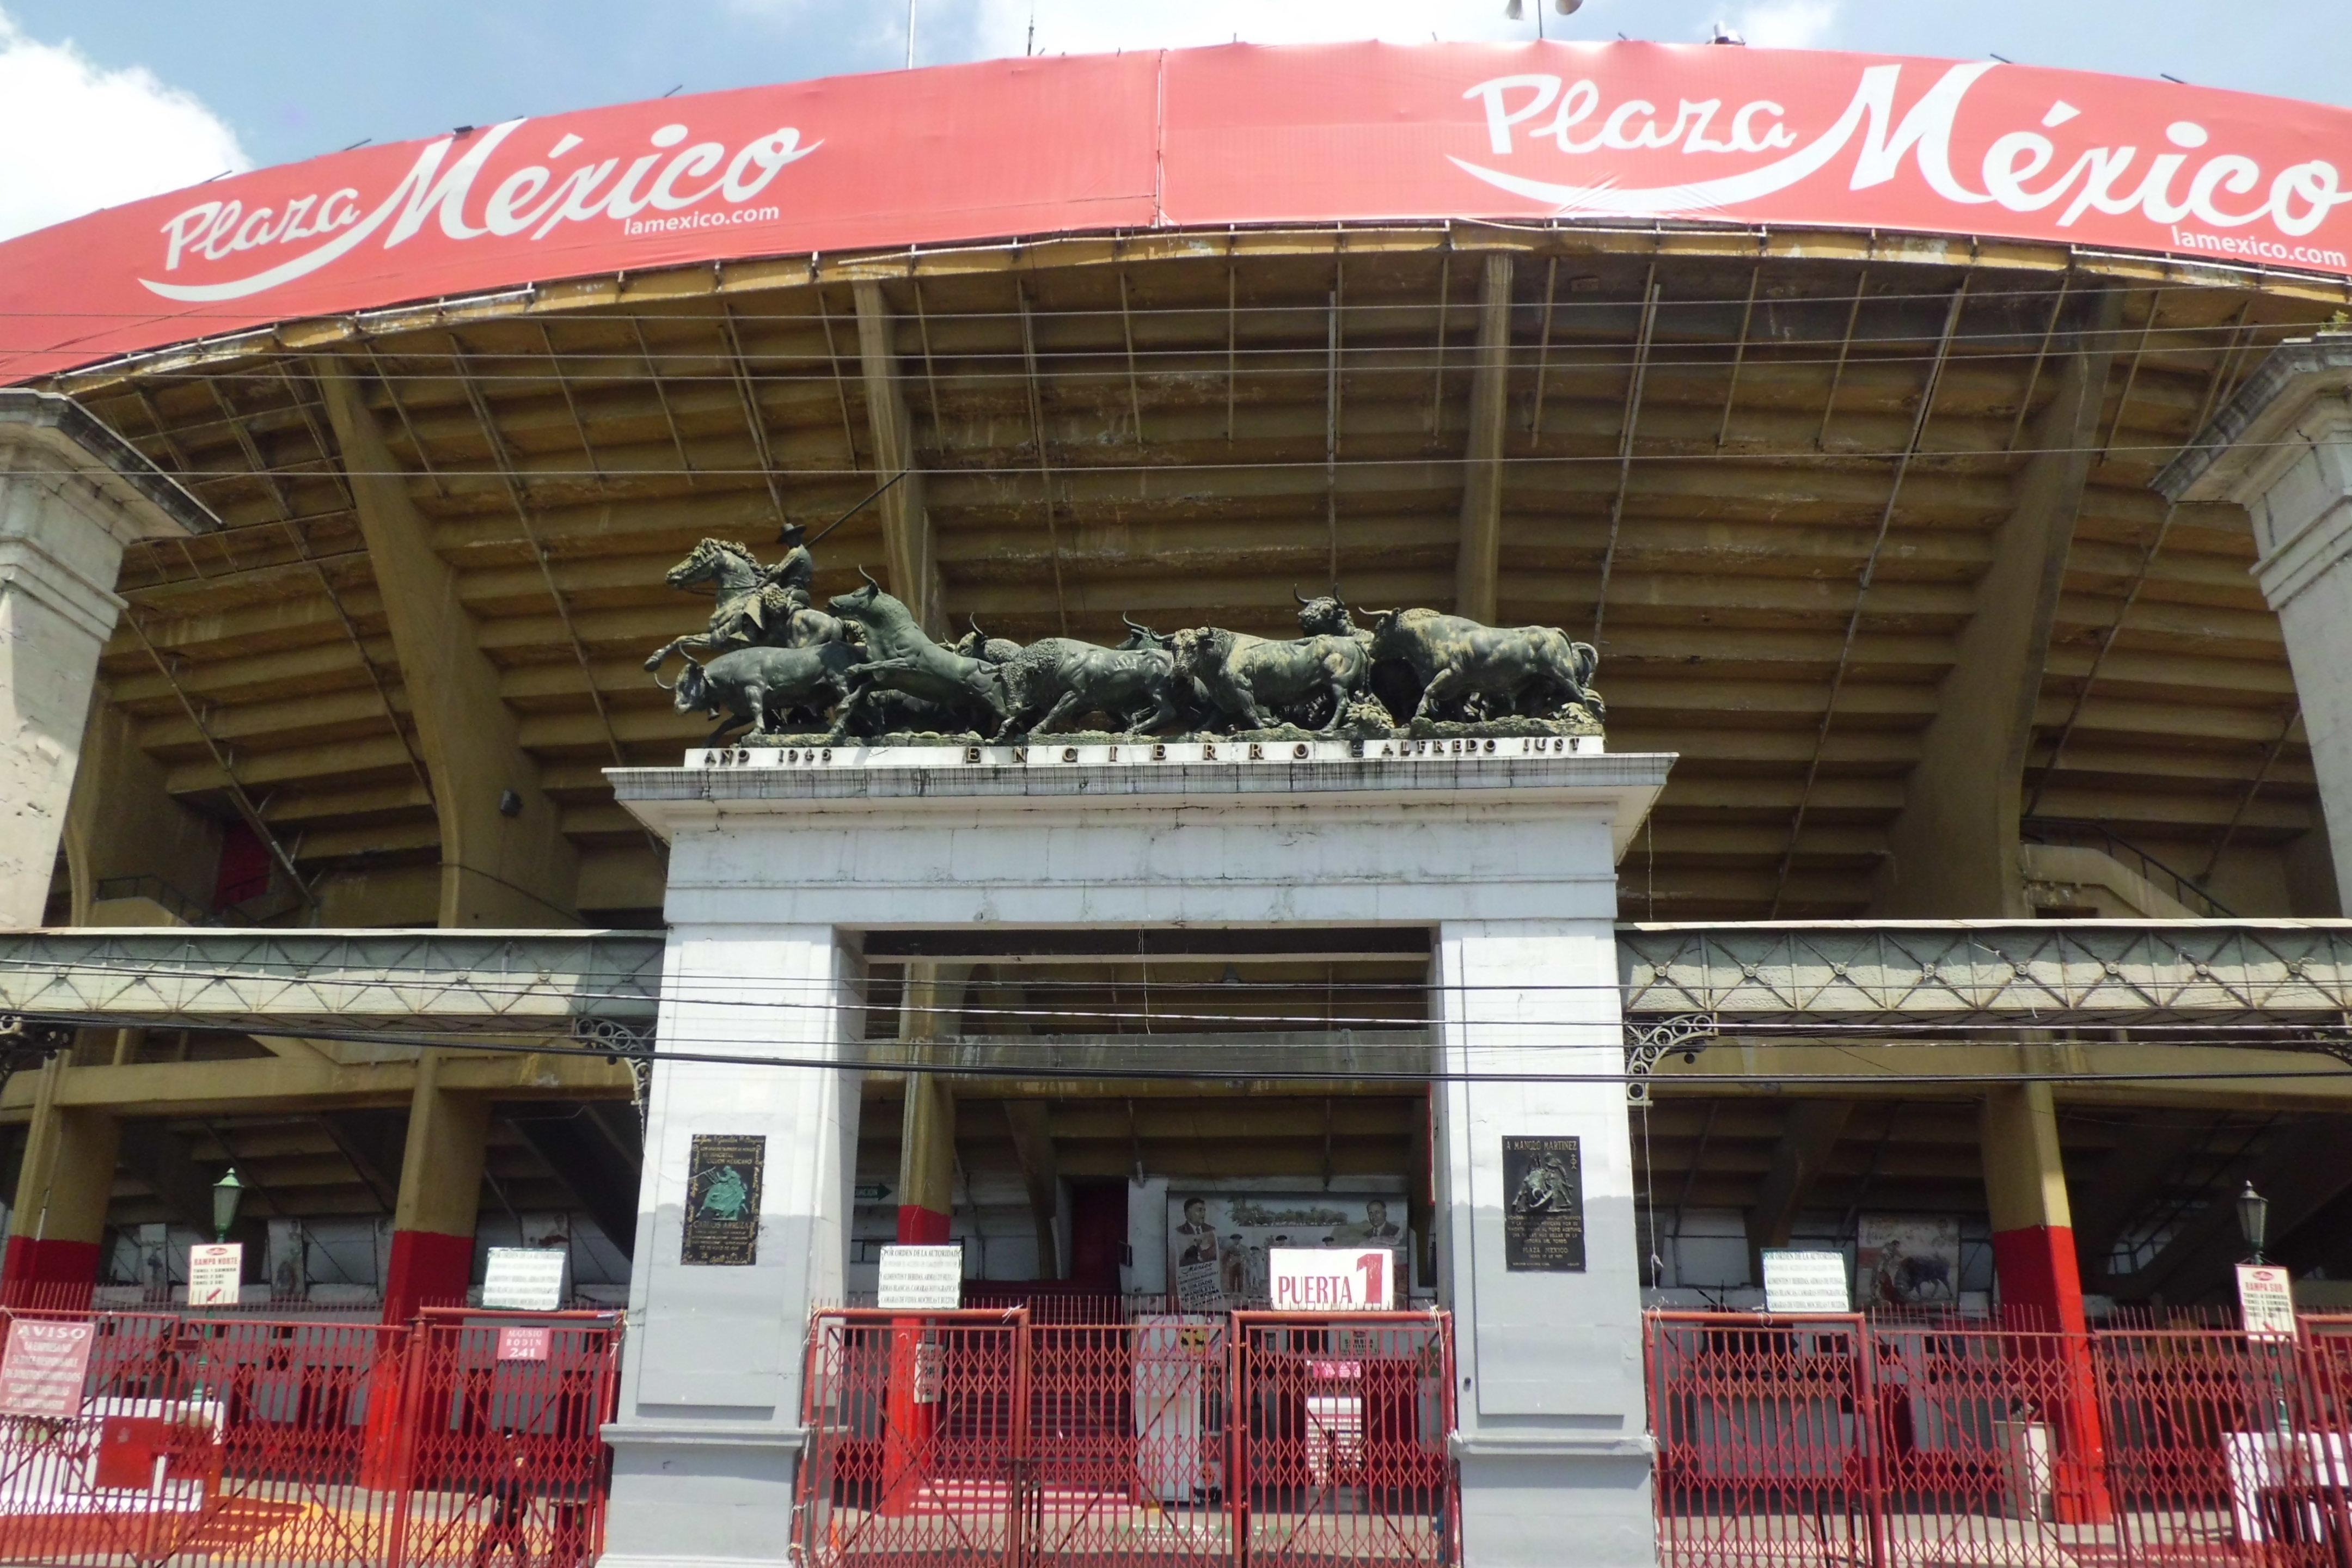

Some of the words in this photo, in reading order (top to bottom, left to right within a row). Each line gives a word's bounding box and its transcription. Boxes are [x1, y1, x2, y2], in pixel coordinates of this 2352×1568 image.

[1463, 72, 1798, 155] Plaza
[1796, 59, 2352, 229] México
[160, 187, 361, 270] Plaza
[340, 118, 825, 250] México
[624, 203, 780, 236] lamexico.com
[2171, 224, 2348, 268] lamexico.com
[778, 748, 832, 762] 1946
[966, 742, 1309, 762] ENCIERRO
[1381, 738, 1496, 757] ALFREDO
[1522, 737, 1581, 752] JUST
[1506, 1141, 1511, 1150] A
[1544, 1141, 1577, 1150] MARTINEZ
[1278, 1276, 1352, 1304] PUERTA
[1356, 1253, 1383, 1304] 1
[17, 1325, 87, 1339] AVISO
[506, 1338, 542, 1346] RODIN
[509, 1347, 535, 1357] 241
